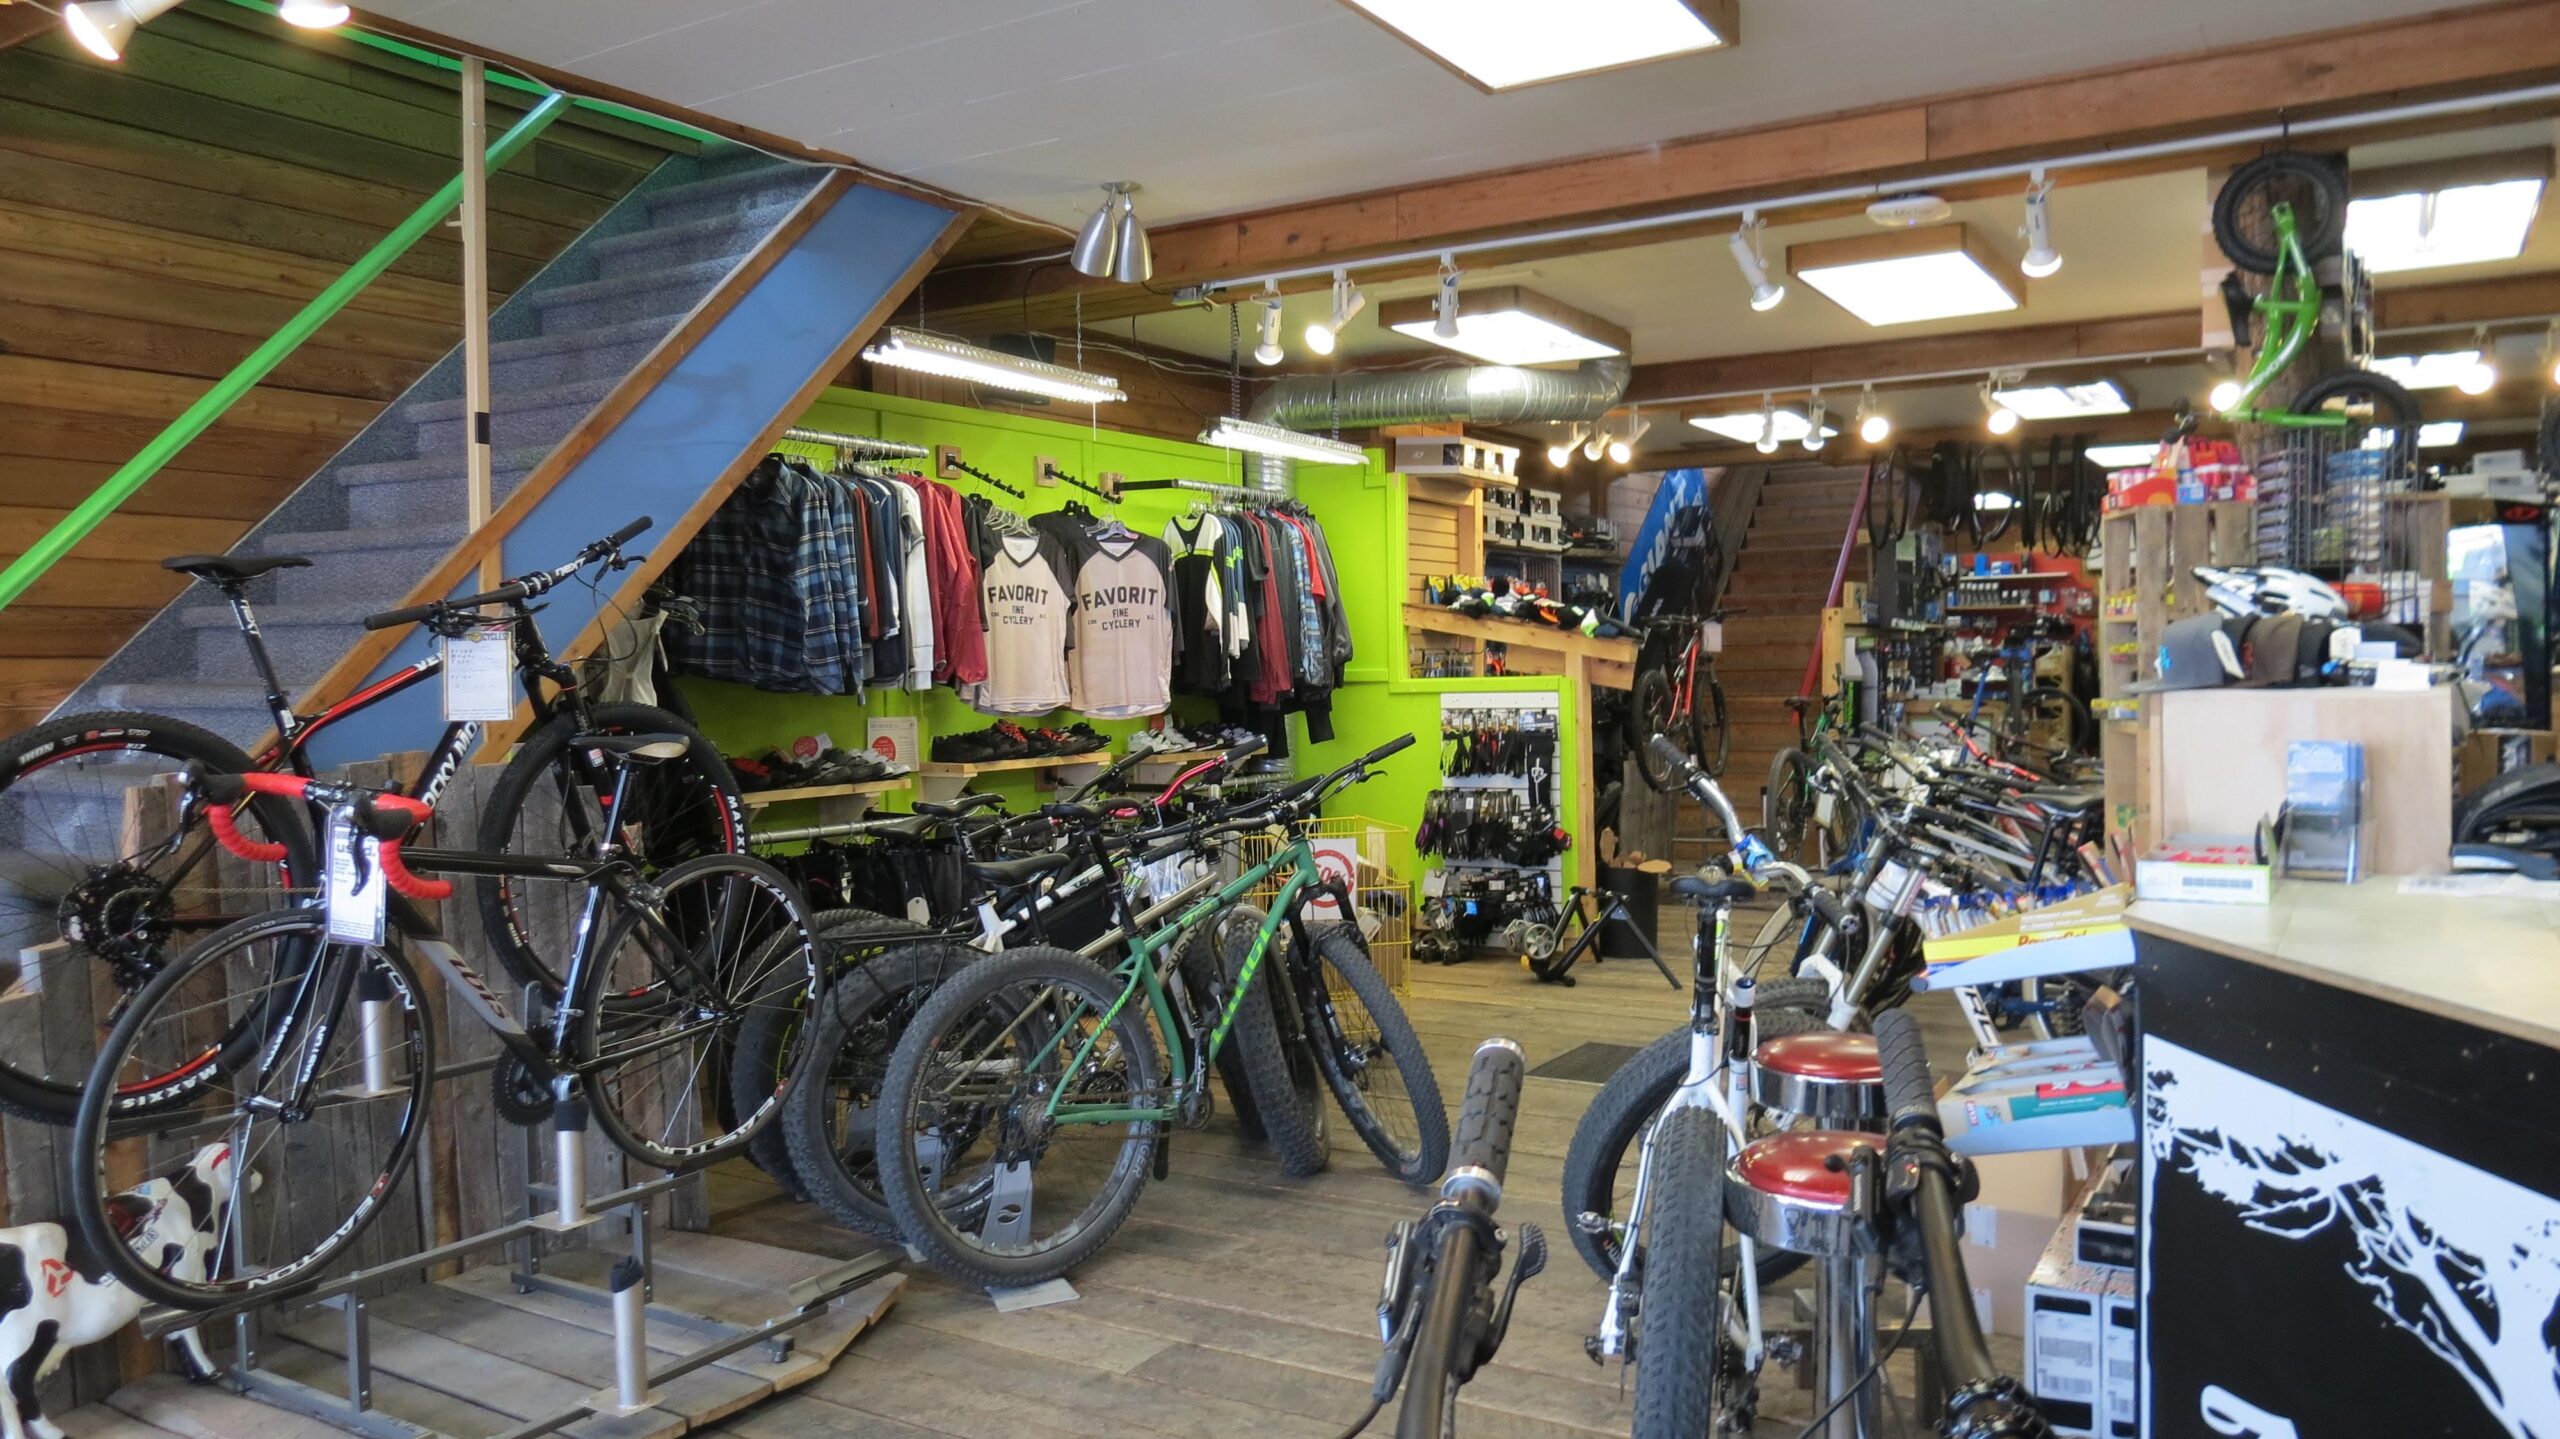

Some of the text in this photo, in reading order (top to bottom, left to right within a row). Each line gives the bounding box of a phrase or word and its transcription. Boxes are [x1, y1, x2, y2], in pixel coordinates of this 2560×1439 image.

[987, 583, 1049, 606] FAVORIT
[1012, 604, 1025, 615] FINE
[1081, 585, 1159, 612] FAVORIT
[1112, 607, 1129, 618] FINE
[1002, 616, 1035, 626] CYCLERY
[1101, 618, 1141, 631] CYCLERY
[421, 752, 457, 810] OCKY
[726, 795, 746, 855] MAXXI
[1164, 923, 1199, 976] SURLY
[301, 1025, 327, 1083] EASTON
[121, 1062, 219, 1110] MAXXIS
[1132, 1078, 1158, 1178] BONRAGER
[248, 1194, 375, 1290] EASTON
